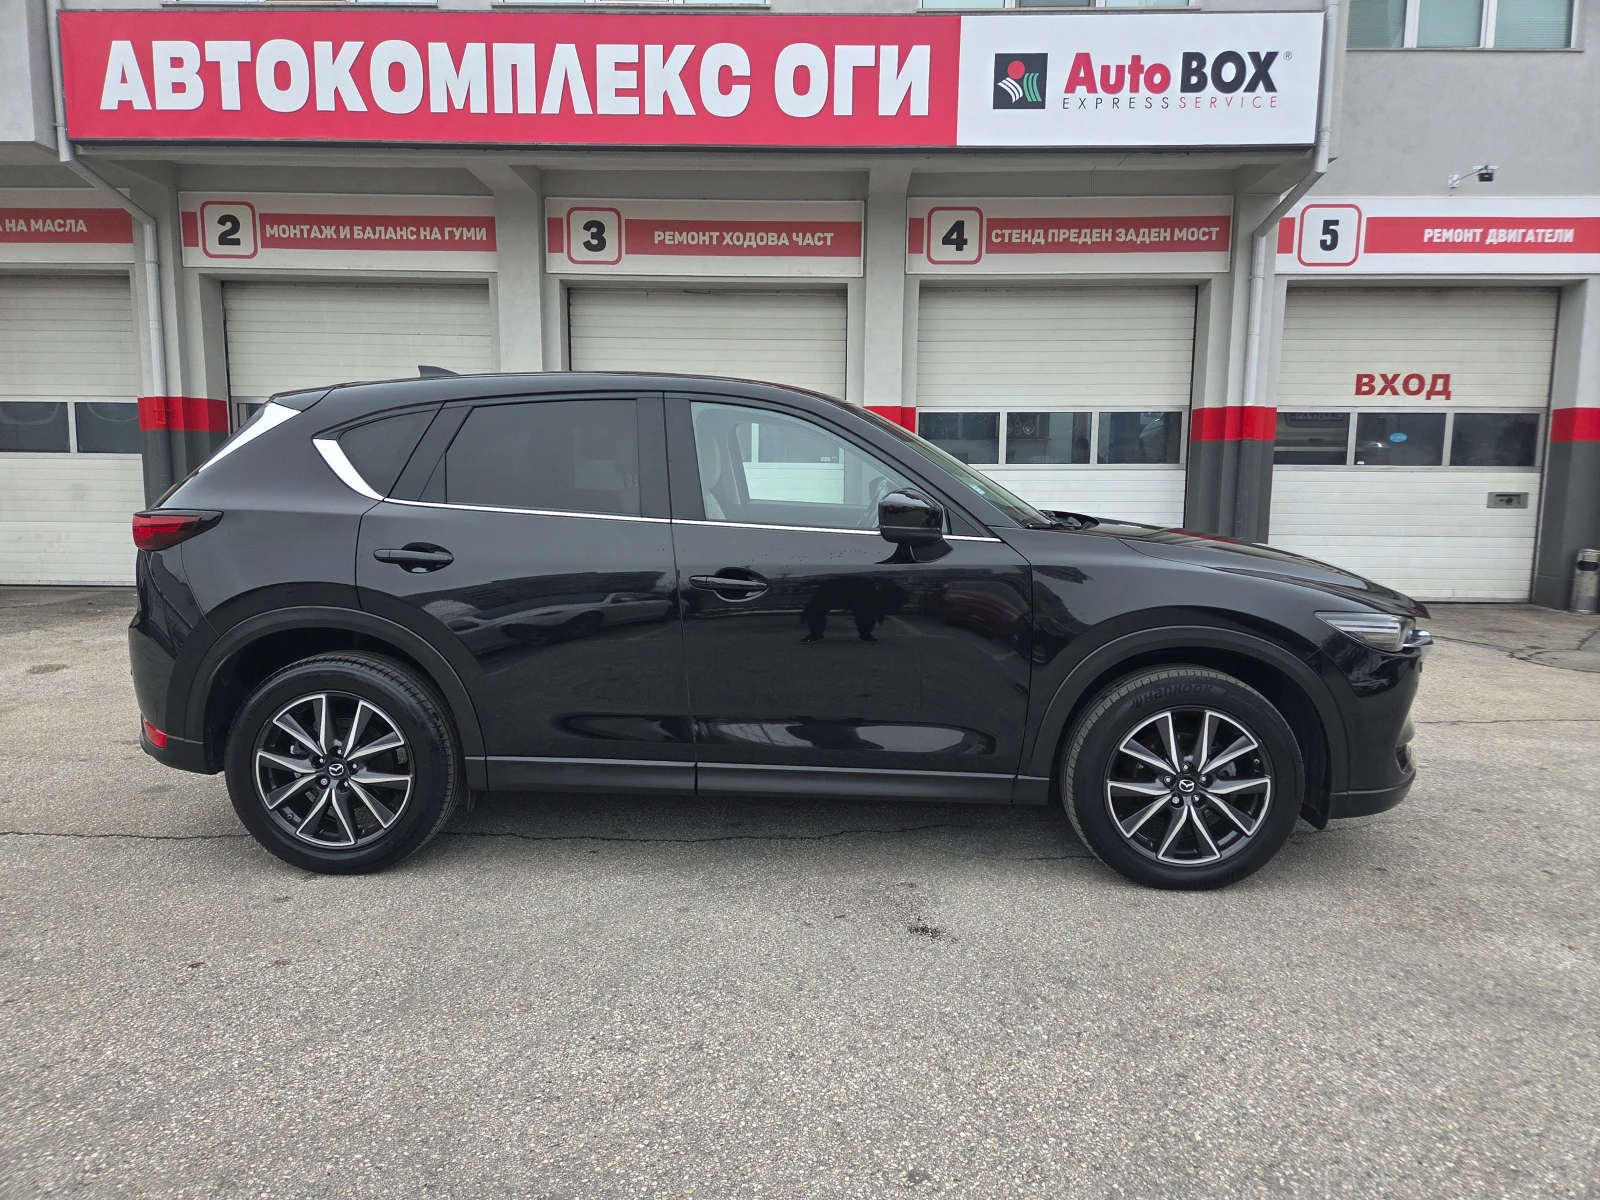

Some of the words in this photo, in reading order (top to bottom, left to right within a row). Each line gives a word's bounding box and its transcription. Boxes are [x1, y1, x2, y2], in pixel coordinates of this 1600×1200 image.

[100, 39, 751, 118] АВТОКОМПЛЕКС
[774, 42, 931, 118] ОГИ
[1064, 52, 1172, 95] Auto
[1180, 50, 1279, 94] BOX
[1062, 97, 1169, 110] EXPRESS
[1178, 96, 1278, 109] SERVICE
[4, 218, 28, 232] НА
[30, 219, 88, 233] МАСЛА
[217, 214, 242, 246] 2
[265, 224, 337, 239] МОНТАЖ
[339, 225, 351, 239] И
[353, 226, 418, 240] БАЛАНС
[420, 226, 442, 240] НА
[444, 227, 487, 241] ГУМИ
[582, 219, 607, 252] 3
[941, 220, 968, 251] 4
[991, 229, 1045, 245] СТЕНД
[1048, 228, 1113, 245] ПРЕДЕН
[1115, 228, 1171, 244] ЗАДЕН
[1174, 227, 1220, 242] МОСТ
[1319, 219, 1340, 251] 5
[1423, 229, 1483, 243] РЕМОНТ
[1485, 229, 1574, 245] ДВИГАТЕЛИ
[654, 231, 720, 245] РЕМОНТ
[722, 231, 790, 248] ХОДОВА
[792, 232, 835, 246] ЧАСТ
[1354, 373, 1452, 400] ВХОД
